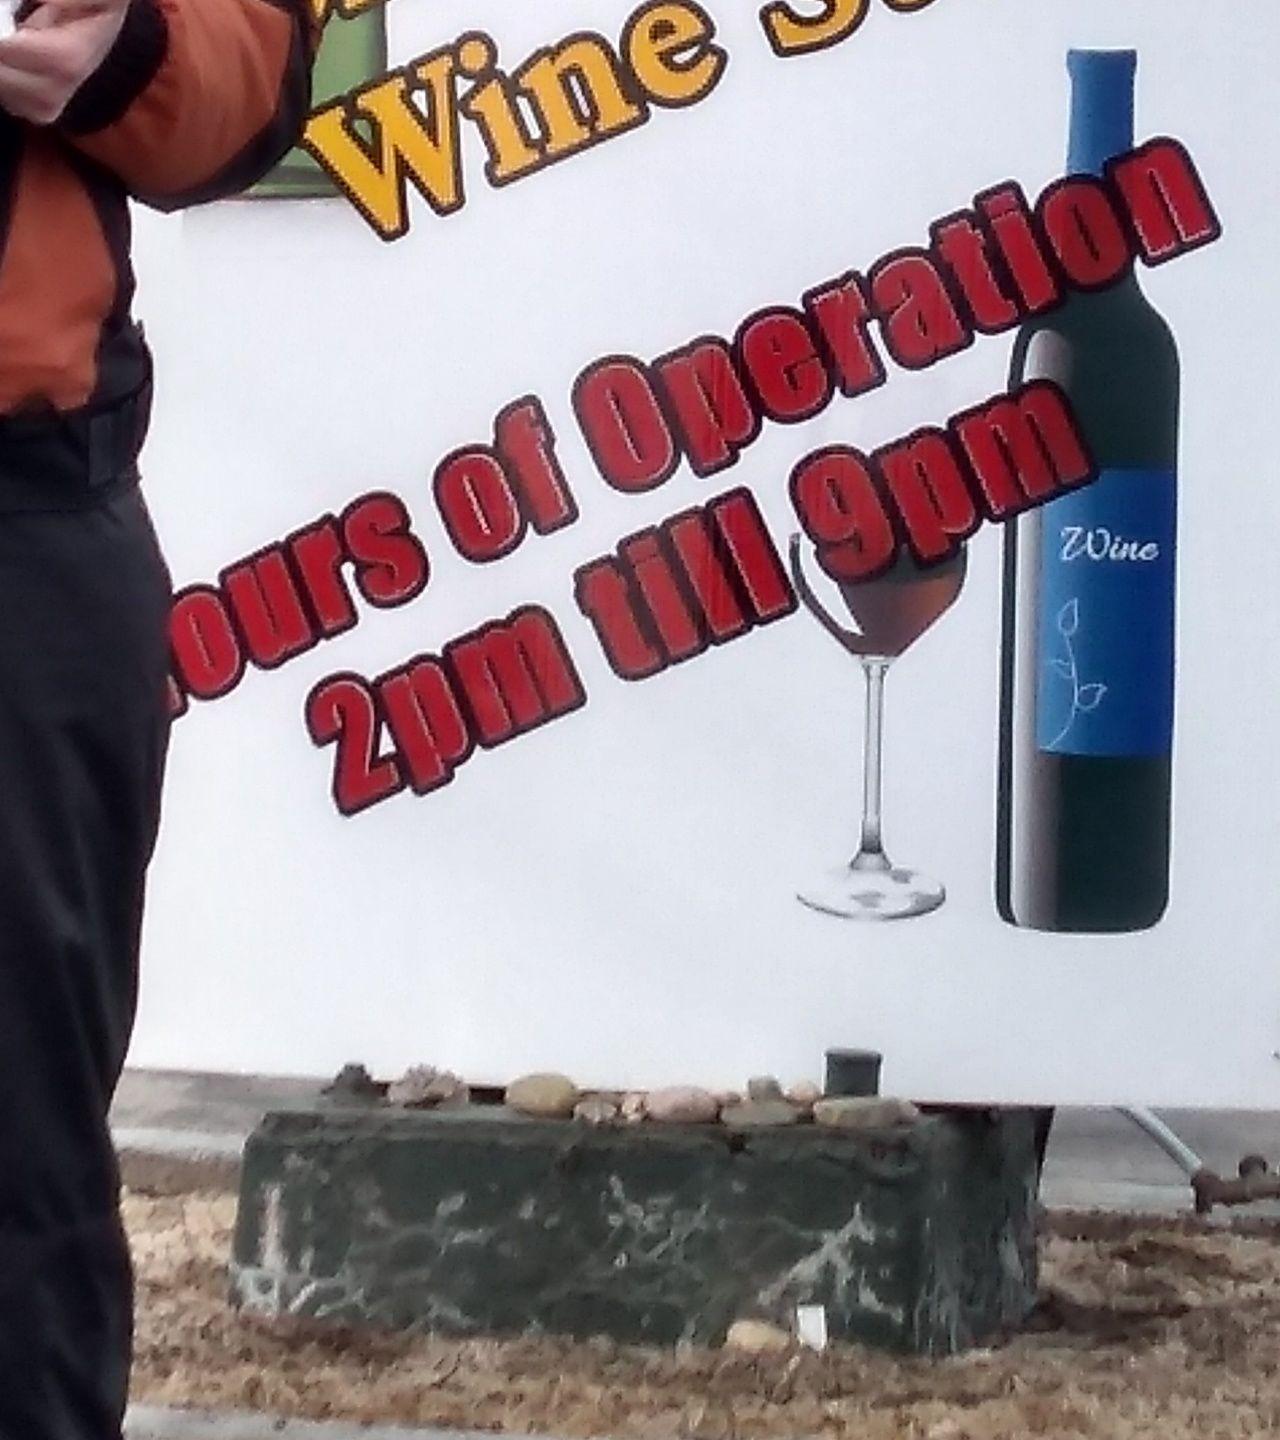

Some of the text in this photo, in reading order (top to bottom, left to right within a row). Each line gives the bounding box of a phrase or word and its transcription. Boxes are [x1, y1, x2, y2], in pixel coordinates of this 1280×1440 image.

[170, 135, 1222, 720] ours of Operation
[305, 378, 1102, 816] 2pm till 9pm
[1060, 525, 1160, 561] Wine
